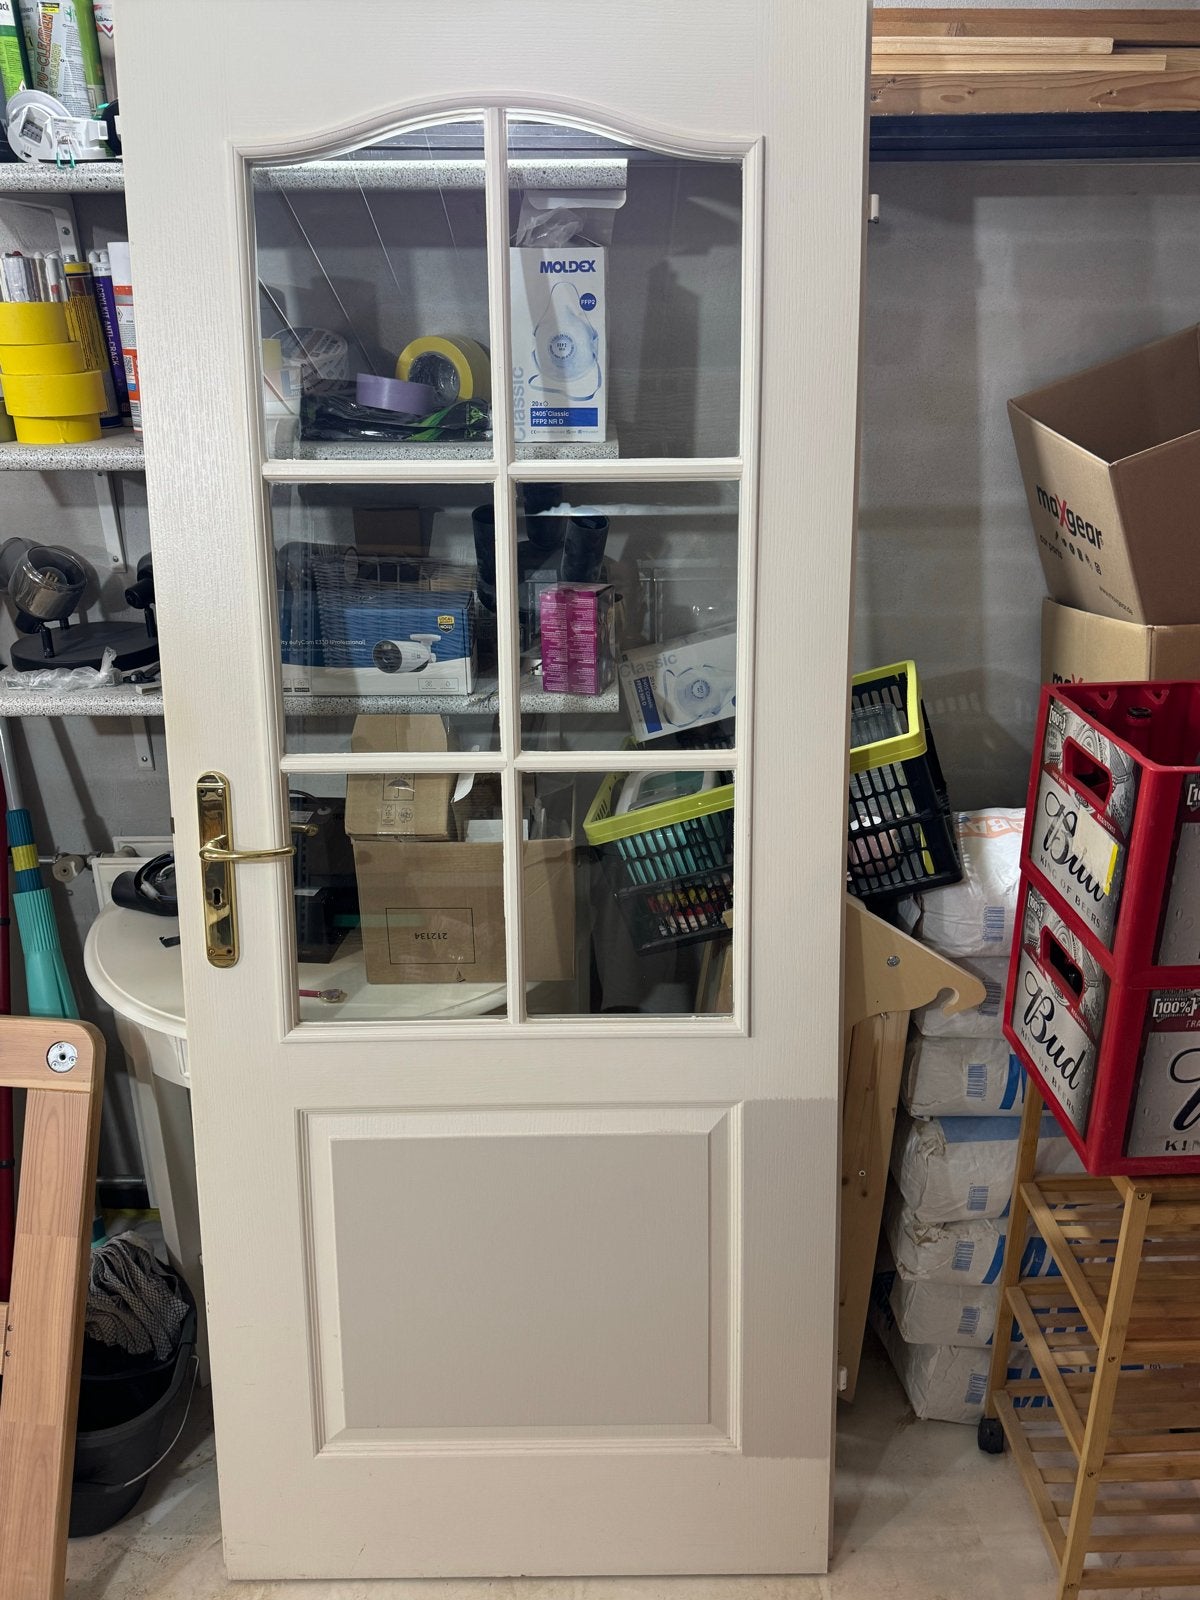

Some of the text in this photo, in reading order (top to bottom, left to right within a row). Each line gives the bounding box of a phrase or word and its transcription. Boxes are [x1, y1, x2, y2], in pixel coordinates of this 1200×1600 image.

[540, 260, 596, 273] MOLDEX
[103, 319, 120, 367] ANTI-CRACK
[513, 366, 527, 442] Classic
[289, 639, 315, 647] eufyCam
[620, 654, 678, 678] Classic
[1060, 878, 1072, 894] OF
[1075, 894, 1101, 929] BEERS
[414, 932, 448, 940] 212134
[1024, 970, 1086, 1090] Bud
